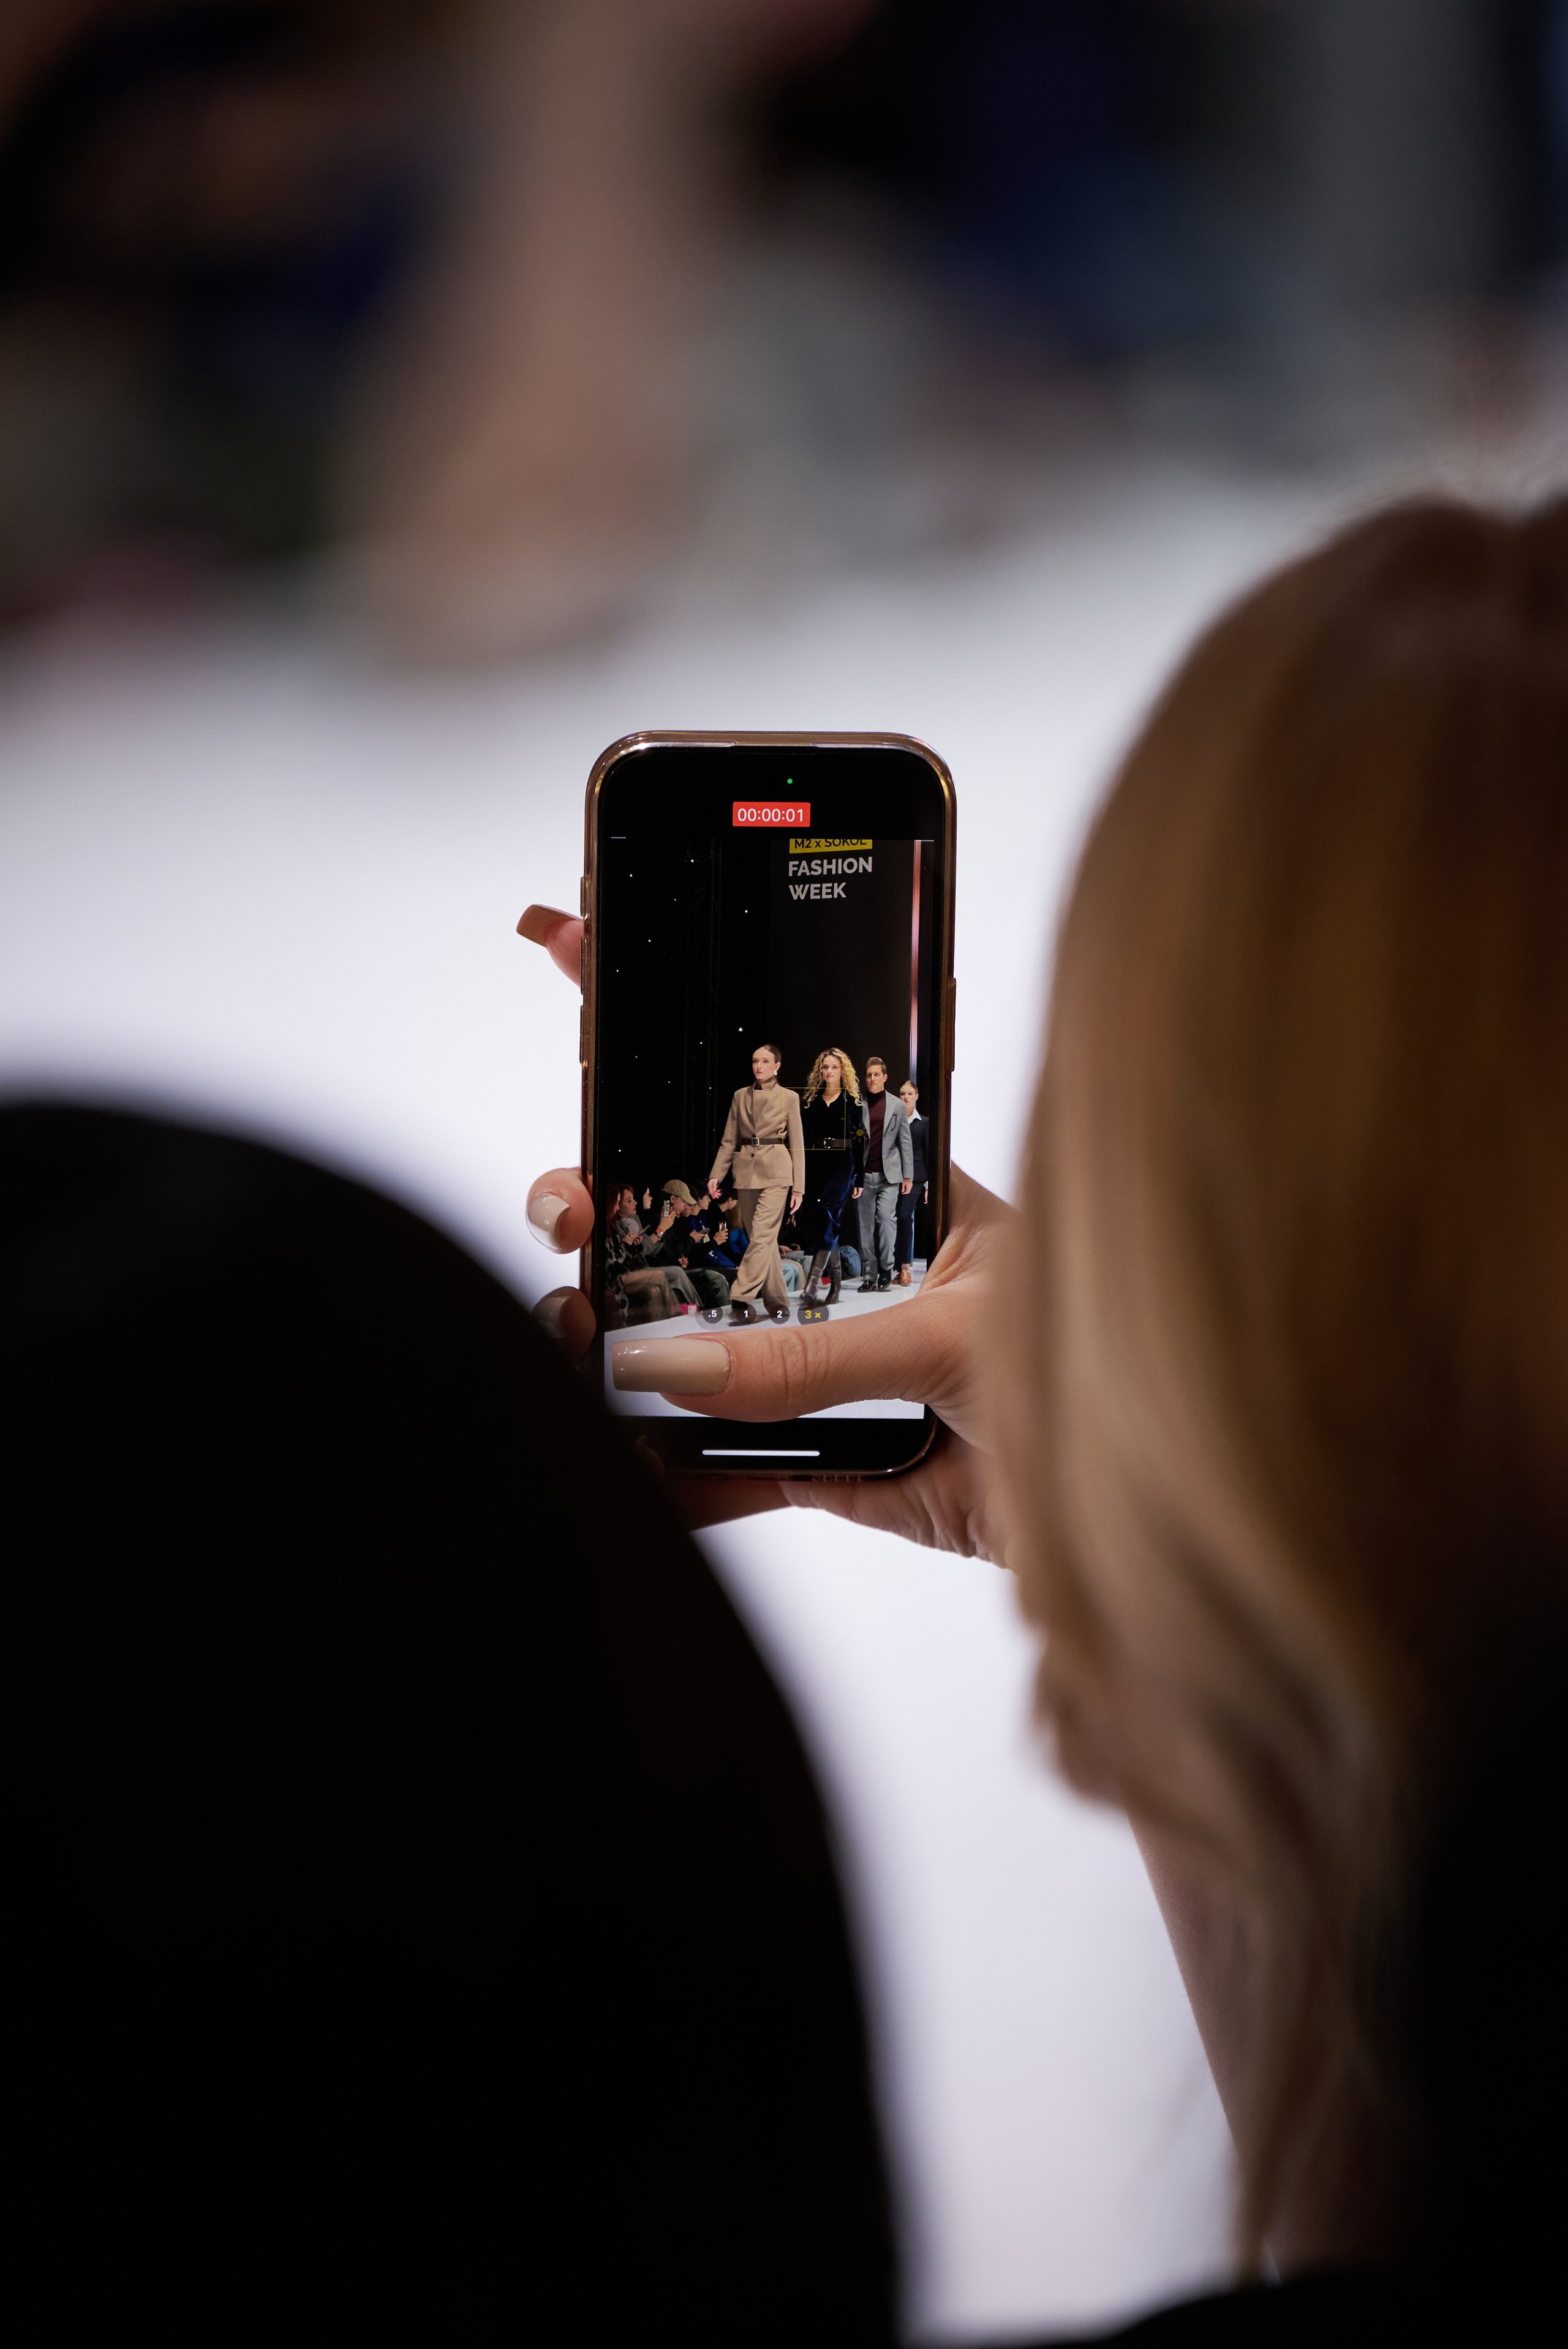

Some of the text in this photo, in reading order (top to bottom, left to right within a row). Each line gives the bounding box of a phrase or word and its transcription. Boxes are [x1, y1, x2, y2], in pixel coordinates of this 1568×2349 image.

[737, 808, 803, 822] 00:00:01
[794, 839, 812, 849] M2
[788, 856, 873, 877] FASHION
[788, 882, 846, 900] WEEK
